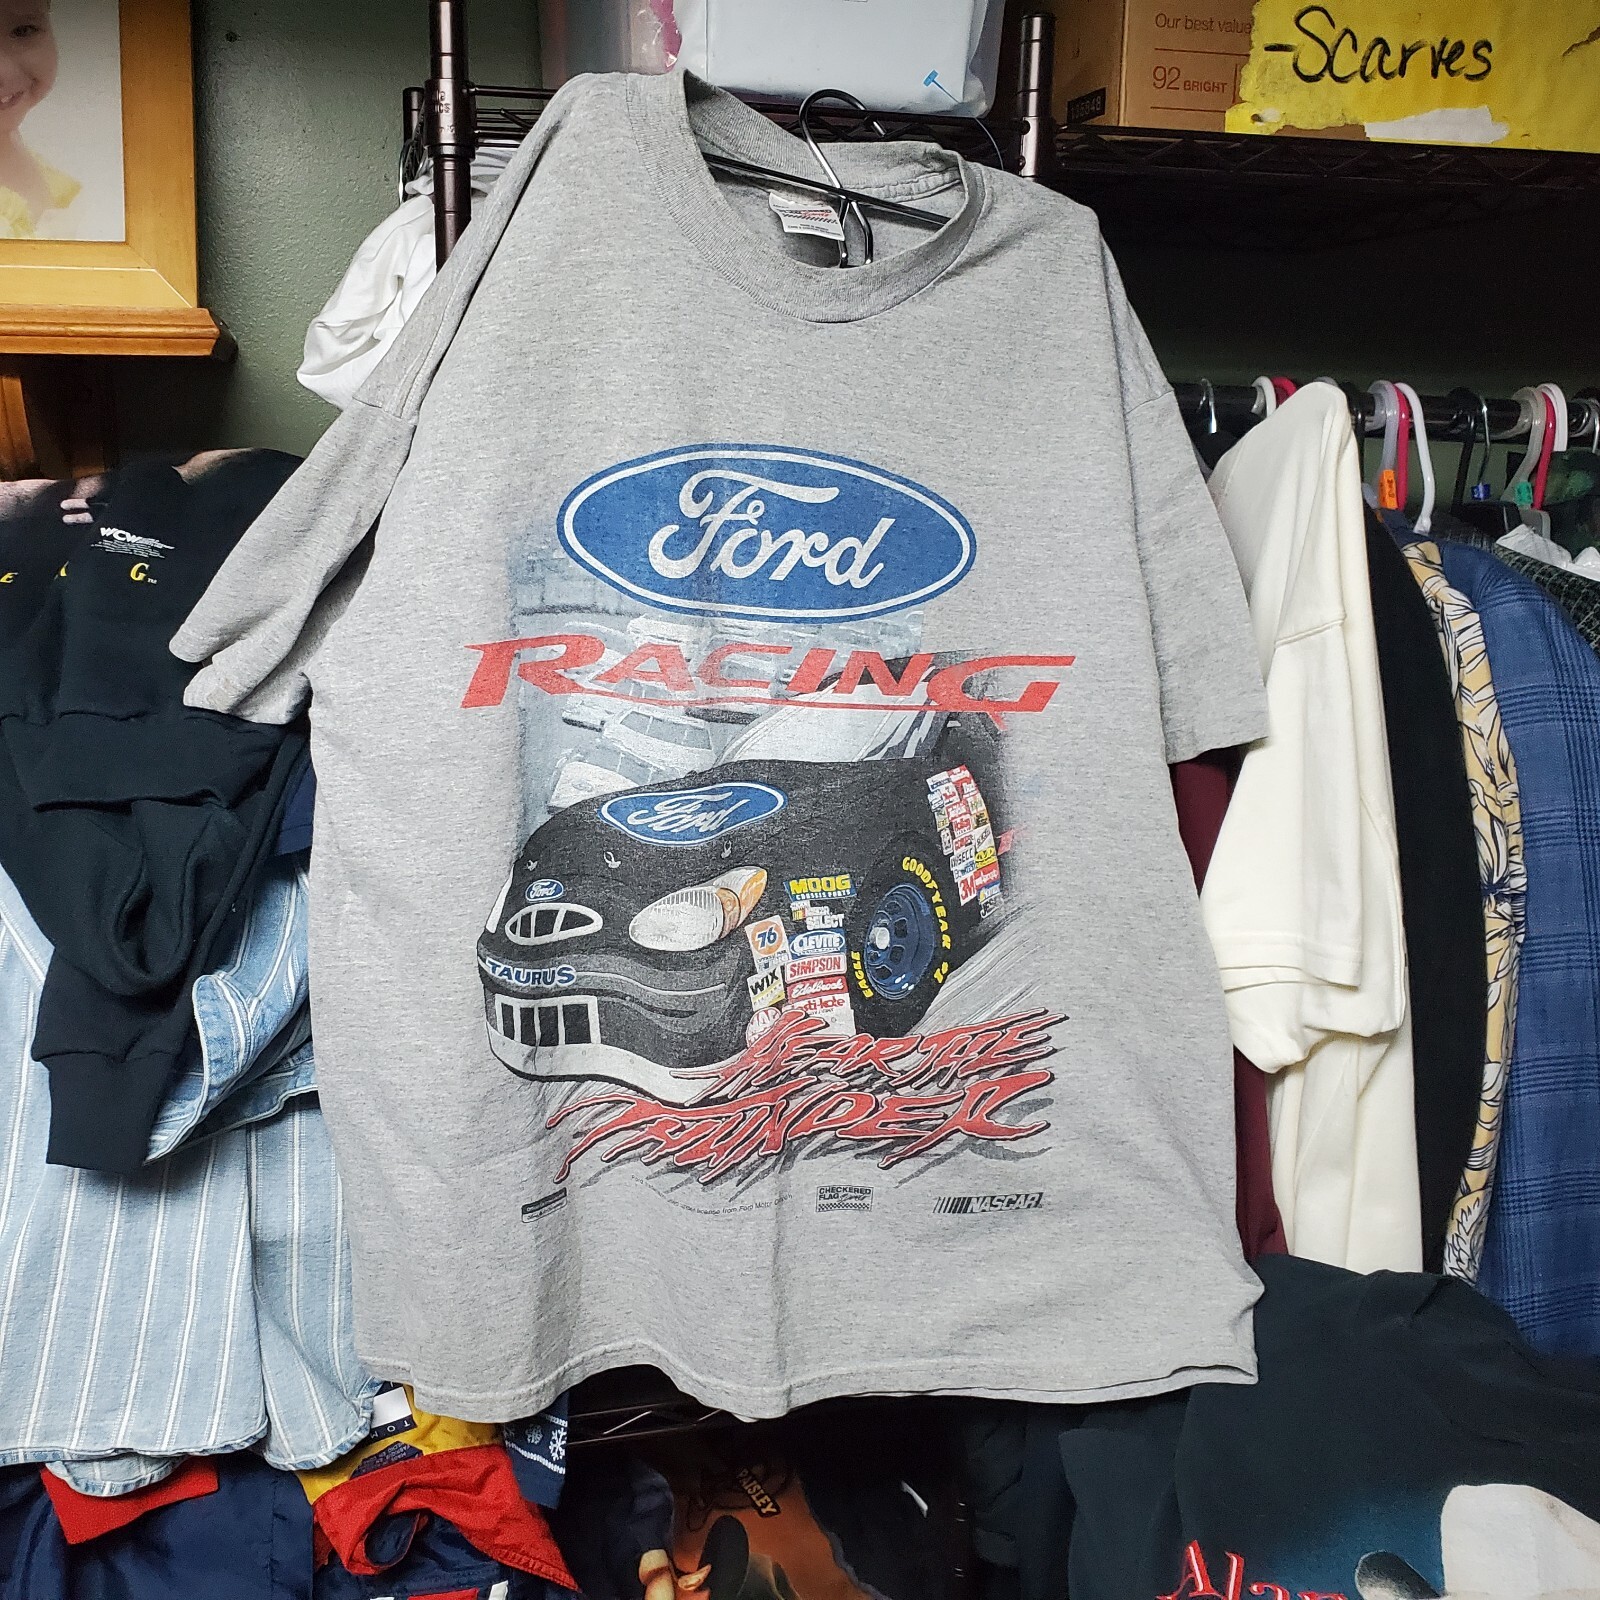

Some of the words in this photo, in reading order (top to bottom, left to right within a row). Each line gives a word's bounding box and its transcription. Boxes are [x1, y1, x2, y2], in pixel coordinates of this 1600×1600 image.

[1155, 13, 1180, 29] Our
[1184, 15, 1214, 32] best
[1152, 65, 1181, 91] 92
[1183, 80, 1228, 94] BRIGHT
[100, 527, 142, 543] WCW
[647, 469, 896, 589] Ford
[459, 634, 1076, 713] RACING
[626, 790, 750, 833] Ford
[530, 881, 557, 899] Ford
[789, 874, 851, 895] MOOG
[902, 856, 951, 949] GOODYEAR
[755, 925, 778, 949] 76
[486, 958, 577, 986] TAURUS
[750, 968, 779, 996] WIX
[851, 951, 874, 998] EAGLE
[670, 1009, 914, 1106] HEAR
[890, 1007, 1068, 1089] THE
[546, 1070, 1055, 1183] THUNDER
[740, 1204, 754, 1212] Ford
[755, 1200, 773, 1209] Motor
[967, 1193, 1041, 1213] NASCAR
[736, 1468, 777, 1514] PAISLEY
